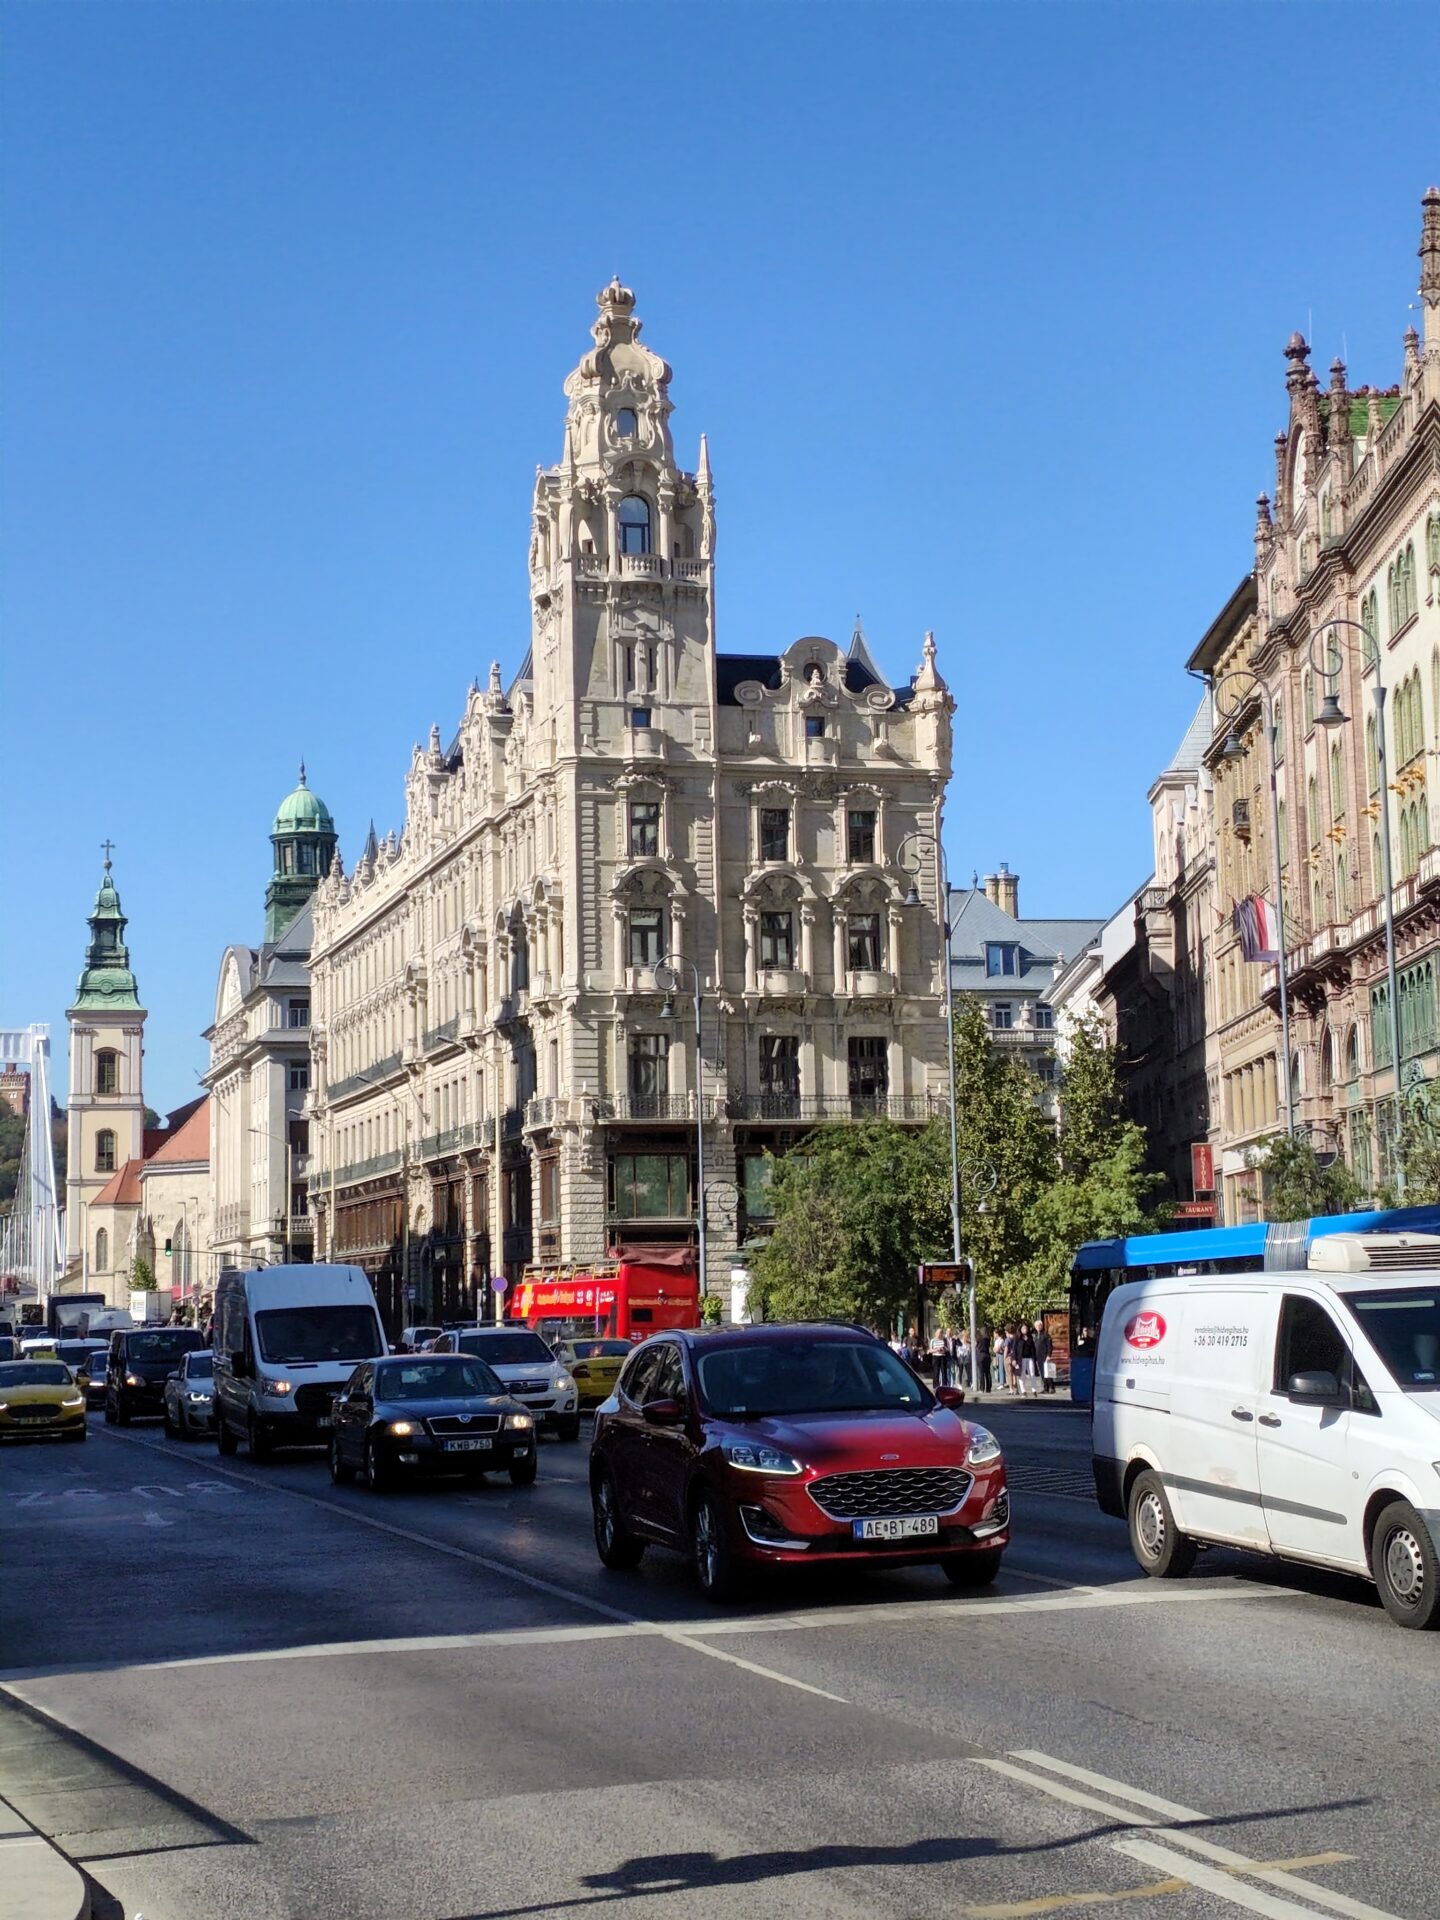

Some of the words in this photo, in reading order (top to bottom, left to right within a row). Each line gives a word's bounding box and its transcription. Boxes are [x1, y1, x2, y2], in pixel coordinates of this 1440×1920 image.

[1178, 1205, 1214, 1213] TAURANT
[1193, 1335, 1206, 1346] +36
[1207, 1335, 1216, 1346] 30
[1217, 1335, 1230, 1346] 419
[1231, 1335, 1248, 1346] 2715
